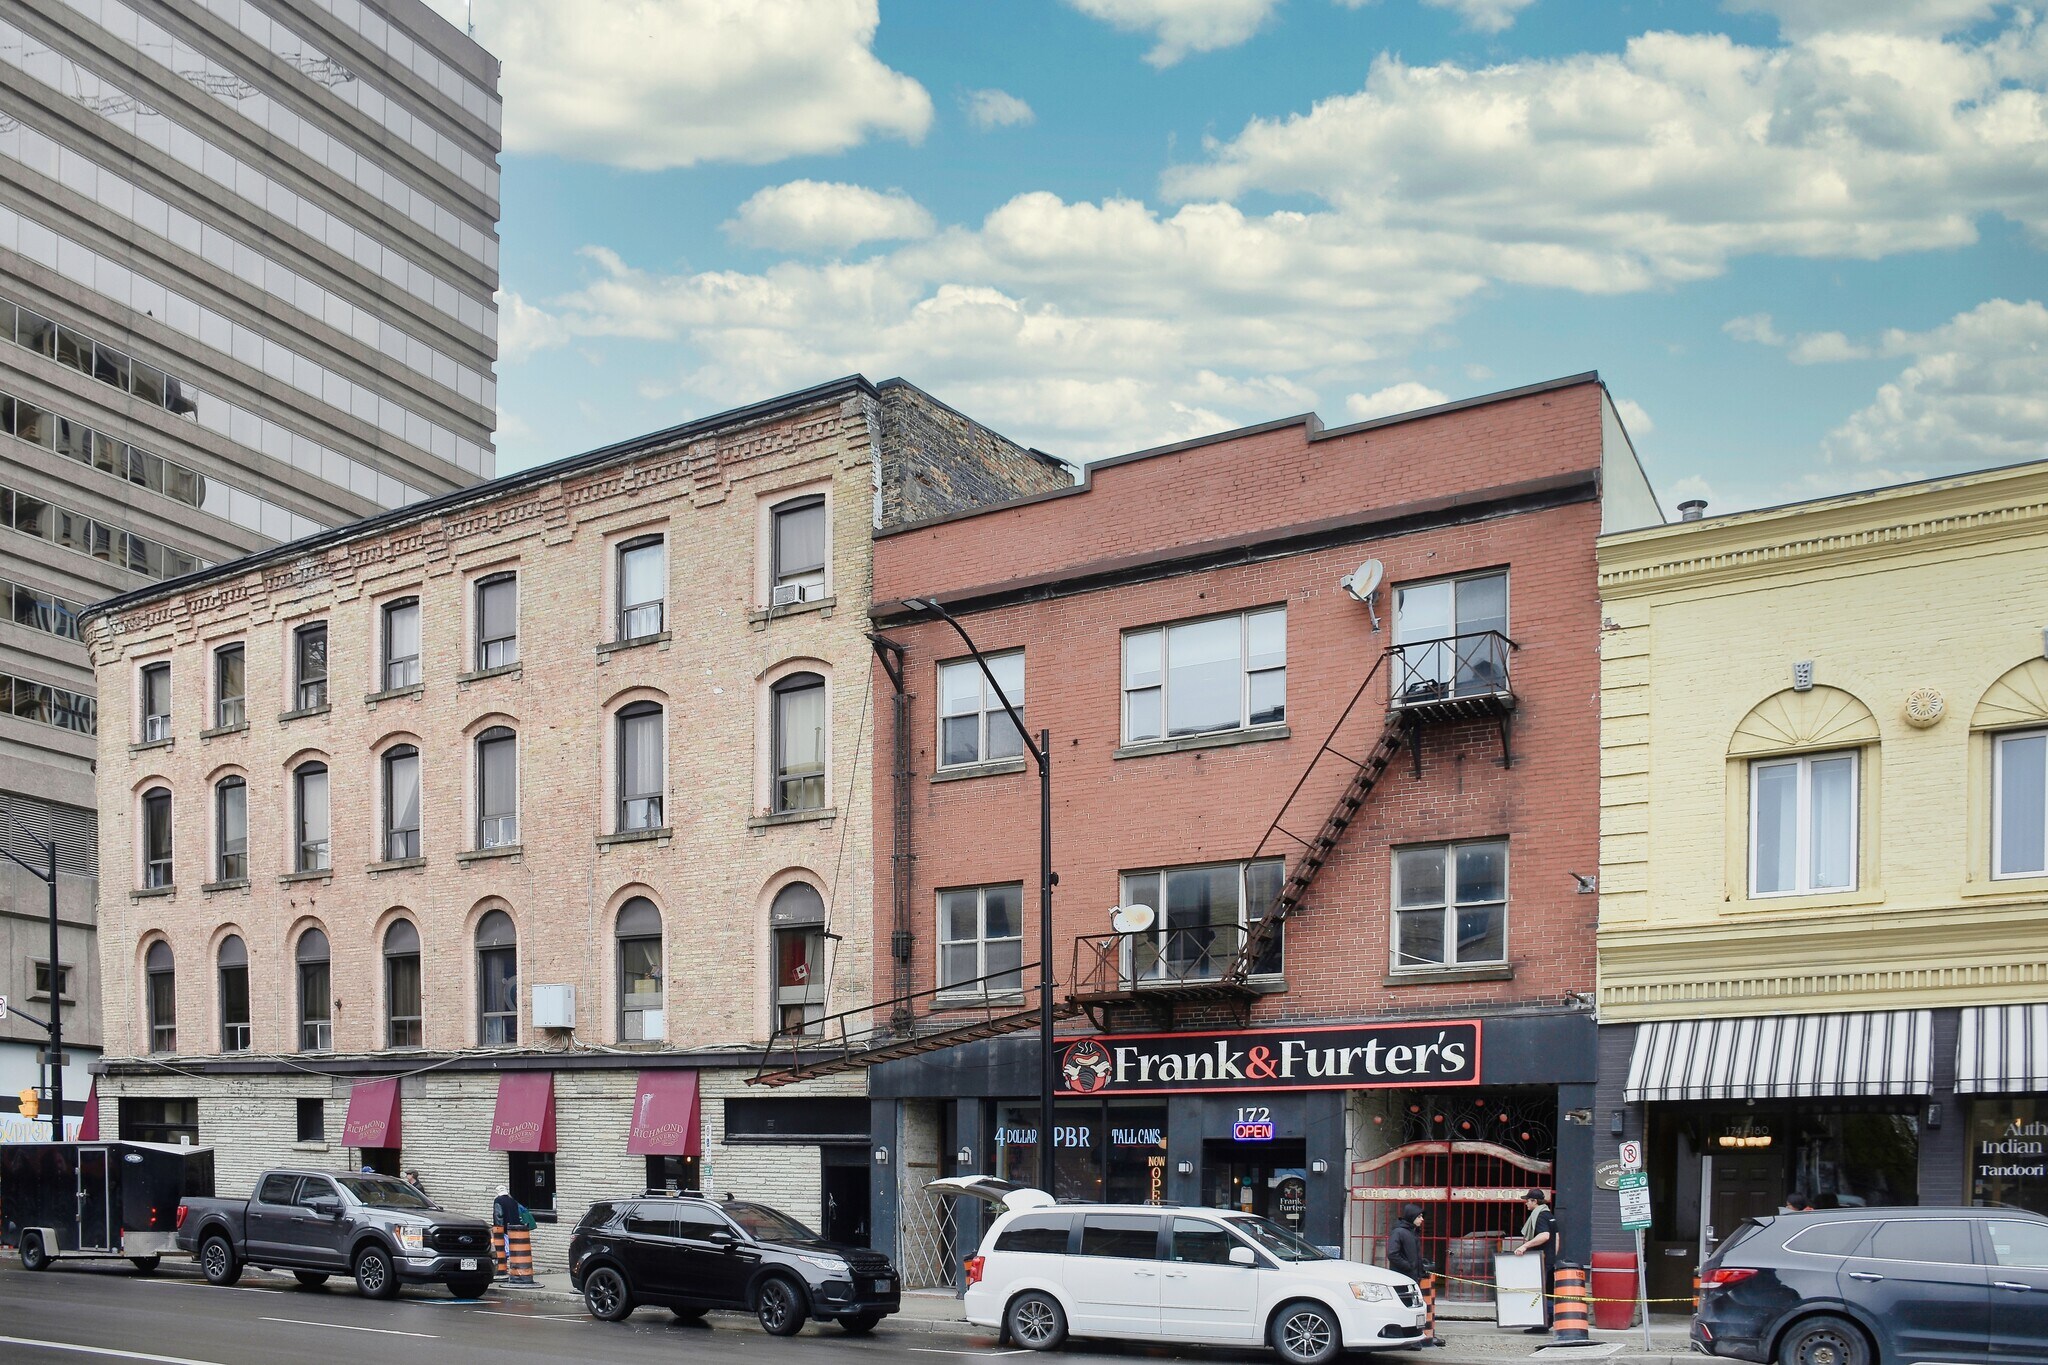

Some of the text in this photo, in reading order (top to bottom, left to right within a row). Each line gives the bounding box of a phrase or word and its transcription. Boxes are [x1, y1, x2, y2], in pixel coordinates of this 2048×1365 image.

[1114, 1031, 1466, 1083] Frank & Furter's
[1237, 1107, 1270, 1122] 172
[346, 1120, 386, 1134] RICHMOND
[494, 1121, 540, 1136] RICHMOND
[633, 1123, 684, 1139] RICHMOND
[1235, 1125, 1271, 1138] OPEN
[2004, 1121, 2048, 1137] Auth
[994, 1126, 1161, 1148] 4 DOLLAR PBR TALL CANS
[1982, 1139, 2043, 1154] Indian
[1148, 1156, 1166, 1167] NOW
[1597, 1163, 1619, 1175] Hudson
[1609, 1169, 1625, 1177] Lodge
[1979, 1164, 2044, 1176] Tandoori
[1464, 1189, 1487, 1199] ON
[1497, 1189, 1527, 1199] KIN
